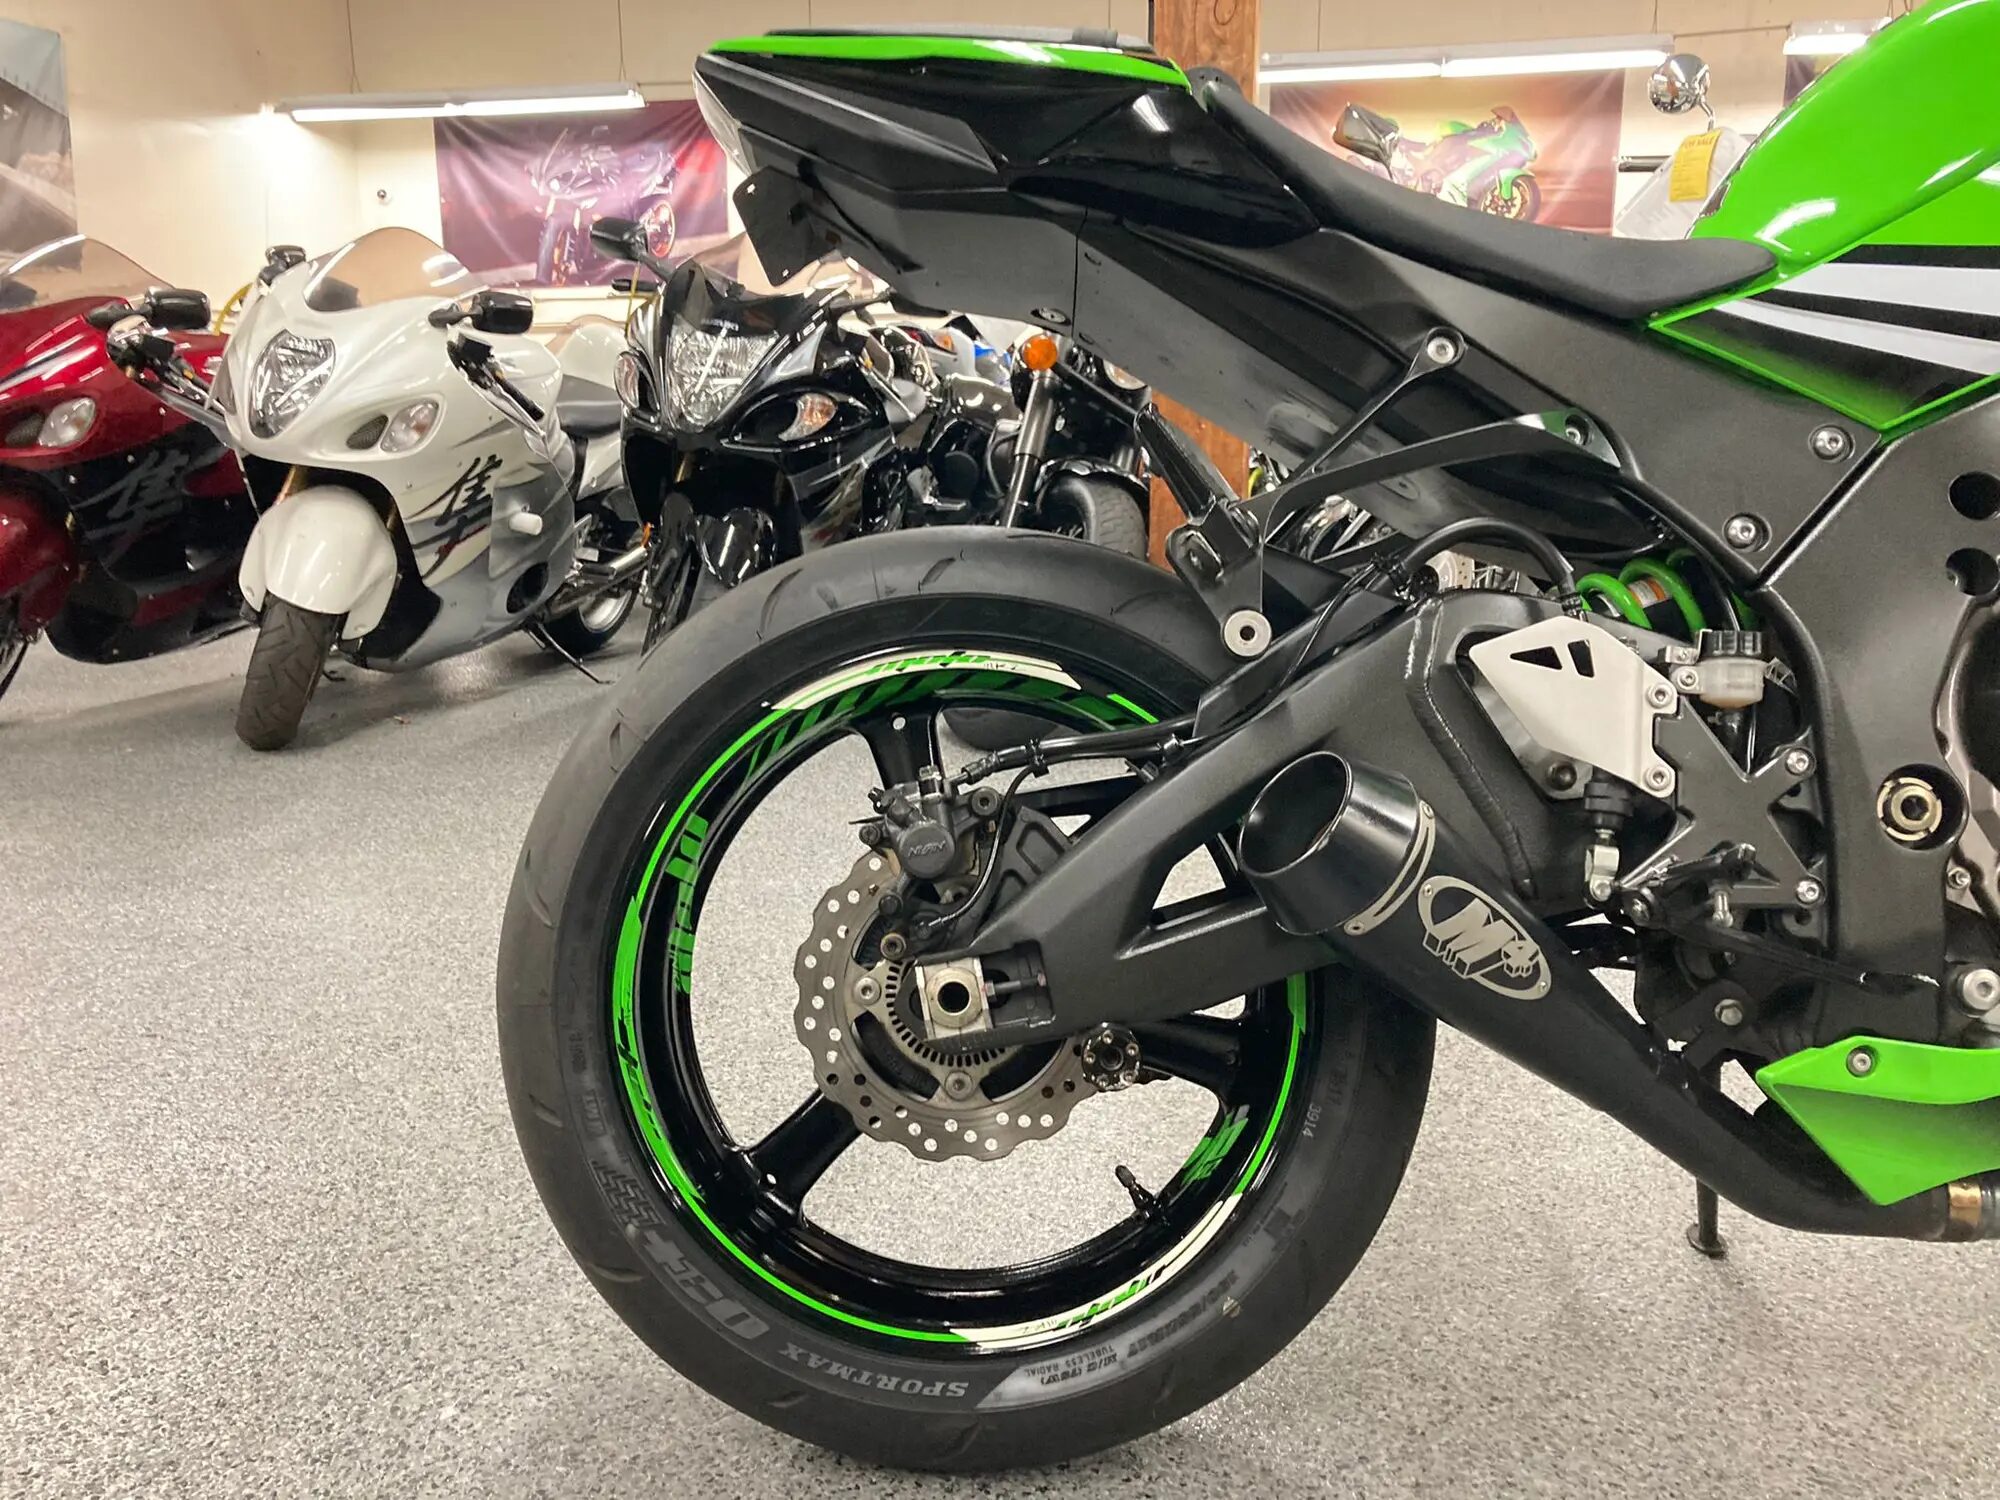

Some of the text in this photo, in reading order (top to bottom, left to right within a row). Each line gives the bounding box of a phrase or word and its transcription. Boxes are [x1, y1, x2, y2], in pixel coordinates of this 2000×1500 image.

[1302, 1102, 1322, 1138] 3914
[779, 1341, 970, 1398] SPORTMAX
[1024, 1345, 1114, 1377] TUBELESS RADIAL
